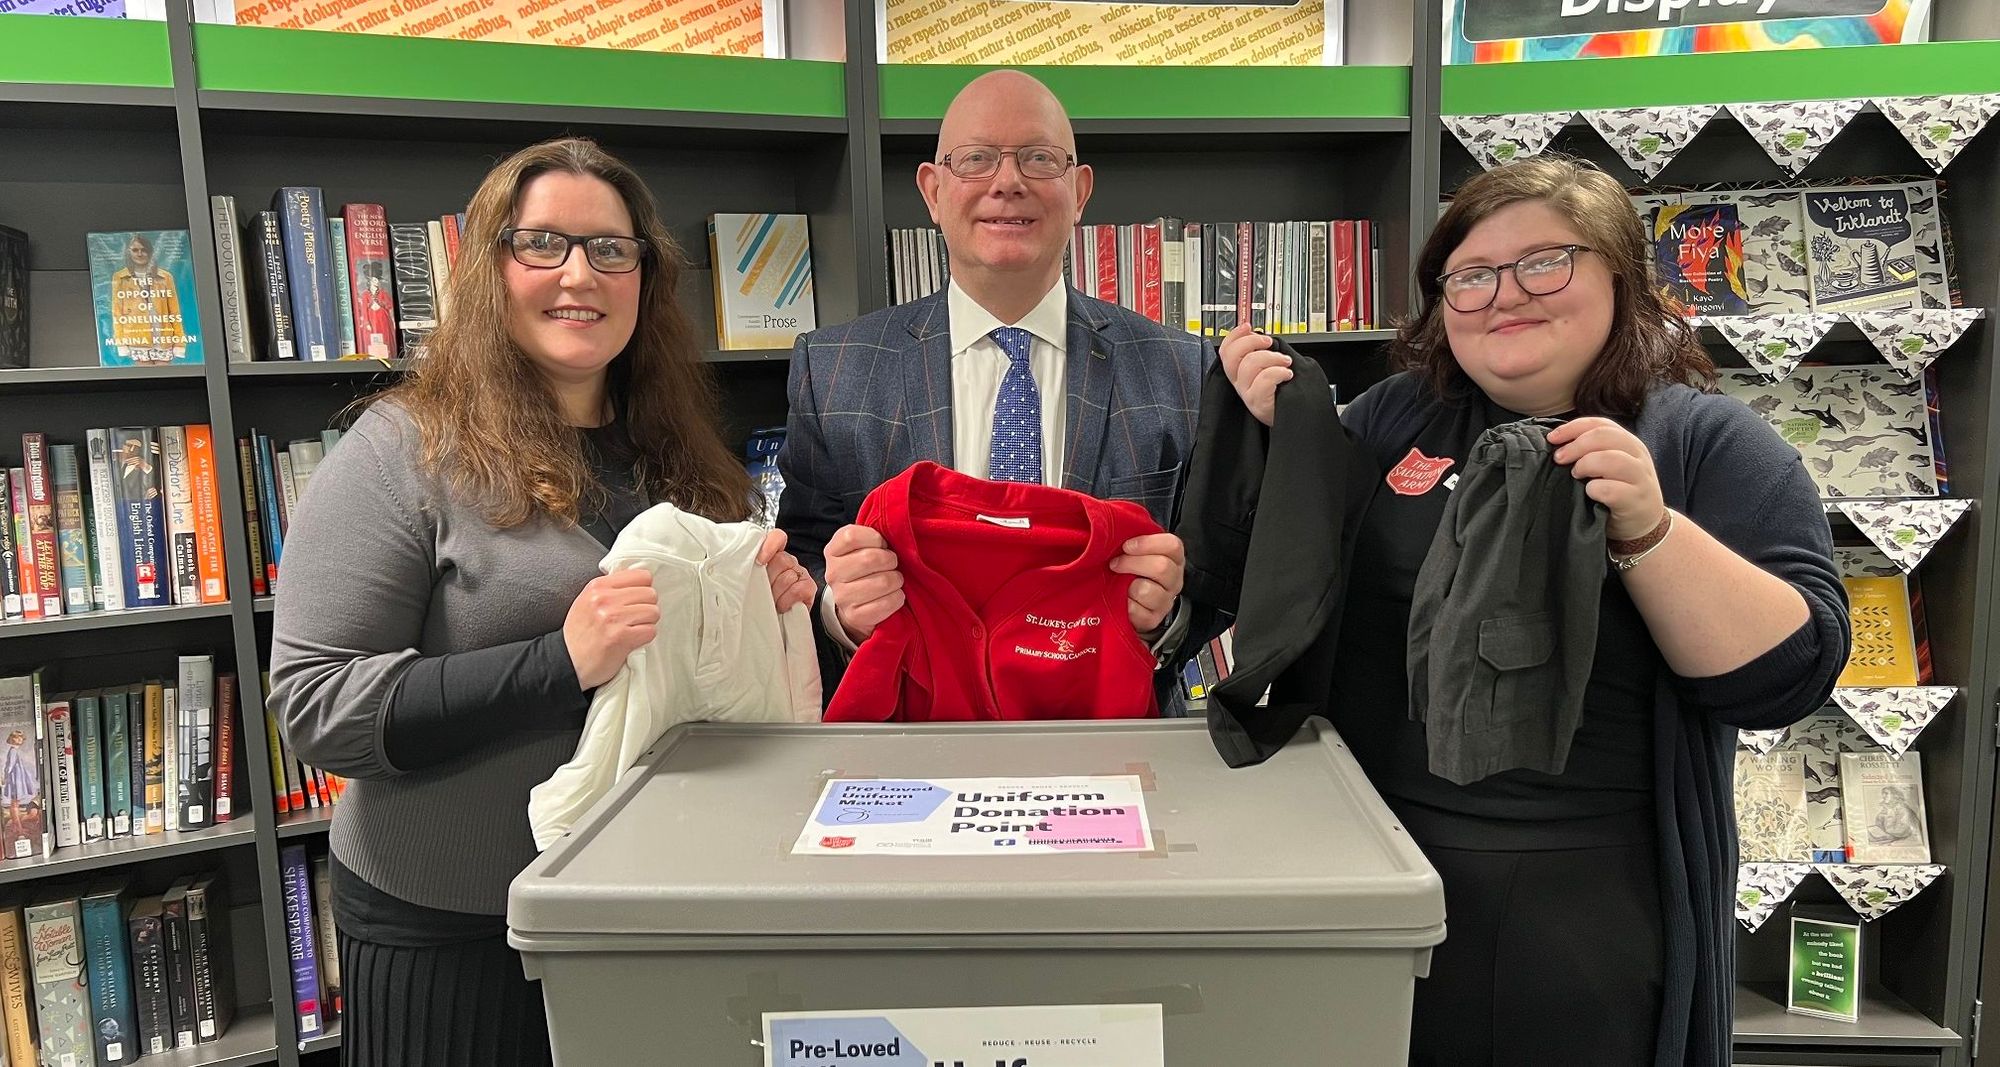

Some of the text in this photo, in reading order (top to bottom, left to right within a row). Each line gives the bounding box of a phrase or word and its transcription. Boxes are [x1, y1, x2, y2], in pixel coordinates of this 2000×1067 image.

[357, 8, 391, 31] ratur
[453, 0, 480, 20] non
[527, 20, 554, 39] velit
[553, 4, 597, 27] volupta
[660, 3, 717, 34] elis estrum
[893, 5, 930, 28] raecae
[1100, 5, 1131, 24] volore
[586, 14, 627, 40] dolupit
[684, 15, 743, 49] doluptiorio
[937, 8, 1023, 55] doluptatas exces
[978, 38, 1005, 60] ratur
[1005, 31, 1016, 47] si
[1015, 8, 1072, 42] omnitaque
[1109, 14, 1156, 44] nobiscitat
[1116, 44, 1138, 61] velit
[1138, 28, 1175, 51] volupta
[1174, 12, 1207, 34] tesciet
[1165, 36, 1201, 60] dolupit
[1202, 20, 1234, 43] eceatis
[1235, 11, 1252, 28] aut
[1230, 21, 1282, 52] elis estrum
[1012, 36, 1057, 64] tionseni
[1055, 29, 1078, 46] non
[1251, 31, 1305, 63] doluptiorio
[297, 195, 313, 231] Poetry
[1814, 196, 1894, 214] Velkom to
[1670, 223, 1724, 240] More
[1836, 208, 1903, 232] Inklandt
[354, 232, 388, 240] ENGLISH
[360, 239, 384, 247] VERSE
[303, 232, 317, 265] Please
[1679, 243, 1719, 262] Fiya
[132, 277, 154, 286] THE
[217, 207, 242, 343] THE BOOK OF SORROW
[275, 261, 284, 281] poem
[334, 235, 350, 318] EMERGENCY POET
[116, 289, 174, 299] OPPOSITE
[268, 272, 278, 297] feeling
[138, 302, 154, 312] OF
[1693, 294, 1714, 303] Kayo
[113, 314, 183, 324] LONELINESS
[763, 314, 797, 328] Prose
[105, 335, 198, 346] MARINA KEEGAN
[29, 442, 45, 502] Ron Burgundy
[1412, 459, 1432, 471] THE
[166, 436, 191, 525] A Doctor's Line
[1399, 478, 1434, 489] ARMY
[128, 502, 143, 535] English
[145, 515, 154, 536] Oxford
[200, 457, 218, 572] AS KINGFISHERS CATCH FIRE
[35, 539, 49, 591] AT THE TOP!
[44, 540, 56, 588] LET ME OFF
[176, 544, 186, 575] Calman
[185, 538, 196, 572] Kenneth
[140, 568, 152, 578] R
[1026, 614, 1100, 629] ST. LUKE'S (C)
[1015, 646, 1068, 660] PRIMARY SCHOOL
[55, 722, 69, 803] THE MINISTRY OF TRUTH
[220, 725, 232, 789] FULL BOOKS SUSAN
[957, 791, 1104, 802] Uniform
[954, 806, 1125, 818] Donation
[950, 822, 1053, 833] Point
[299, 878, 308, 906] OXFORD
[282, 866, 304, 961] SHAKESPEARE
[33, 924, 73, 943] Notable
[302, 907, 312, 947] COMPANION
[34, 934, 74, 952] Woman
[306, 948, 313, 958] TO
[2, 925, 23, 1010] WITS & WIVES
[97, 953, 105, 976] THIRD
[104, 934, 118, 1008] CHARLES WILLIAMS
[150, 944, 160, 993] TESTAMENT
[202, 954, 208, 966] WE
[142, 960, 151, 988] YOUTH
[194, 949, 205, 1005] SHEILA KOHLER
[203, 968, 211, 989] WERE
[1816, 970, 1844, 982] brilliant
[100, 978, 109, 1011] INKLING
[205, 990, 214, 1019] SISTERS
[1808, 989, 1825, 998] about
[790, 1038, 900, 1059] Pre-Loved
[1060, 1038, 1097, 1046] RECYCLE
